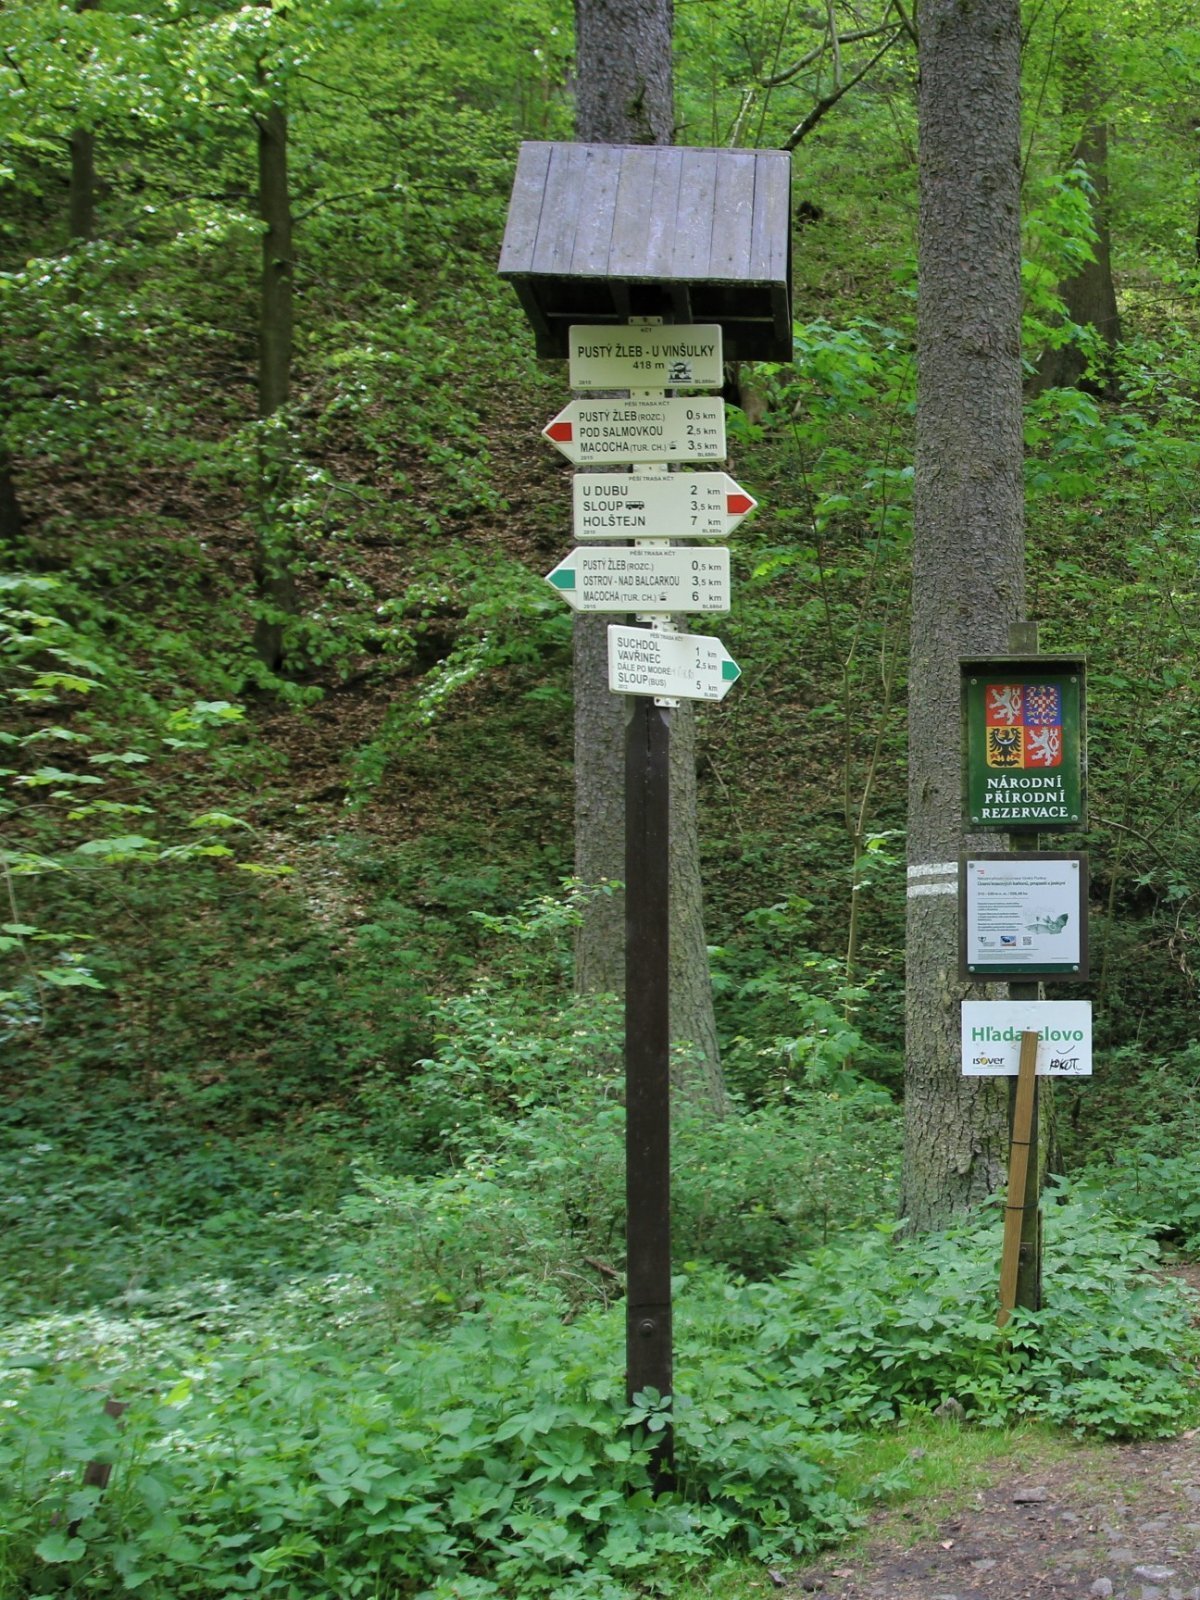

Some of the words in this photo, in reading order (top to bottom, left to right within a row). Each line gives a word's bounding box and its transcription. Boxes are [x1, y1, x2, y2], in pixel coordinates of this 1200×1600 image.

[578, 343, 612, 358] PUSTÝ
[615, 343, 643, 358] ŽLEB
[652, 345, 659, 357] U
[662, 342, 715, 357] VINŠULKY
[632, 361, 652, 369] 418
[579, 409, 610, 422] PUSTÝ
[613, 409, 637, 422] ŽLEB
[638, 413, 666, 422] (ROZC.)
[686, 409, 700, 420] 0,5
[580, 427, 600, 438] POD
[603, 426, 663, 437] SALMOVKOU
[686, 425, 701, 436] 2,5
[580, 442, 629, 452] MACOCHA
[630, 444, 649, 453] (TUR.
[651, 444, 667, 452] CH.)
[688, 440, 702, 451] 3,5
[583, 486, 590, 496] U
[595, 486, 628, 496] DUBU
[690, 485, 698, 495] 2
[584, 501, 623, 511] SLOUP
[691, 501, 706, 512] 3,5
[584, 514, 646, 526] HOLŠTEJN
[691, 516, 698, 526] 7
[583, 558, 606, 571] PUSTÝ
[608, 557, 626, 570] ŽLEB
[627, 563, 654, 572] (ROZC.)
[692, 561, 706, 572] 0,5
[583, 576, 613, 586] OSTROV
[618, 576, 634, 586] NAD
[636, 576, 680, 586] BALCARKOU
[692, 576, 706, 587] 3,5
[584, 591, 619, 601] MACOCHA
[621, 594, 639, 602] (TUR.
[642, 594, 657, 602] CH.)
[692, 591, 699, 602] 6
[617, 637, 660, 651] SUCHDOL
[696, 647, 700, 656] 1
[708, 650, 717, 658] km
[618, 649, 661, 664] VAVŘINEC
[696, 659, 707, 670] 2,5
[637, 664, 646, 673] PO
[618, 672, 648, 684] SLOUP
[648, 676, 667, 688] (BUS)
[696, 681, 701, 690] 5
[987, 774, 1062, 789] NÁRODNÍ
[985, 789, 1065, 804] PŘÍRODNÍ
[981, 806, 1069, 818] REZERVACE
[972, 1026, 1023, 1041] Hľada
[1038, 1026, 1084, 1041] slovo
